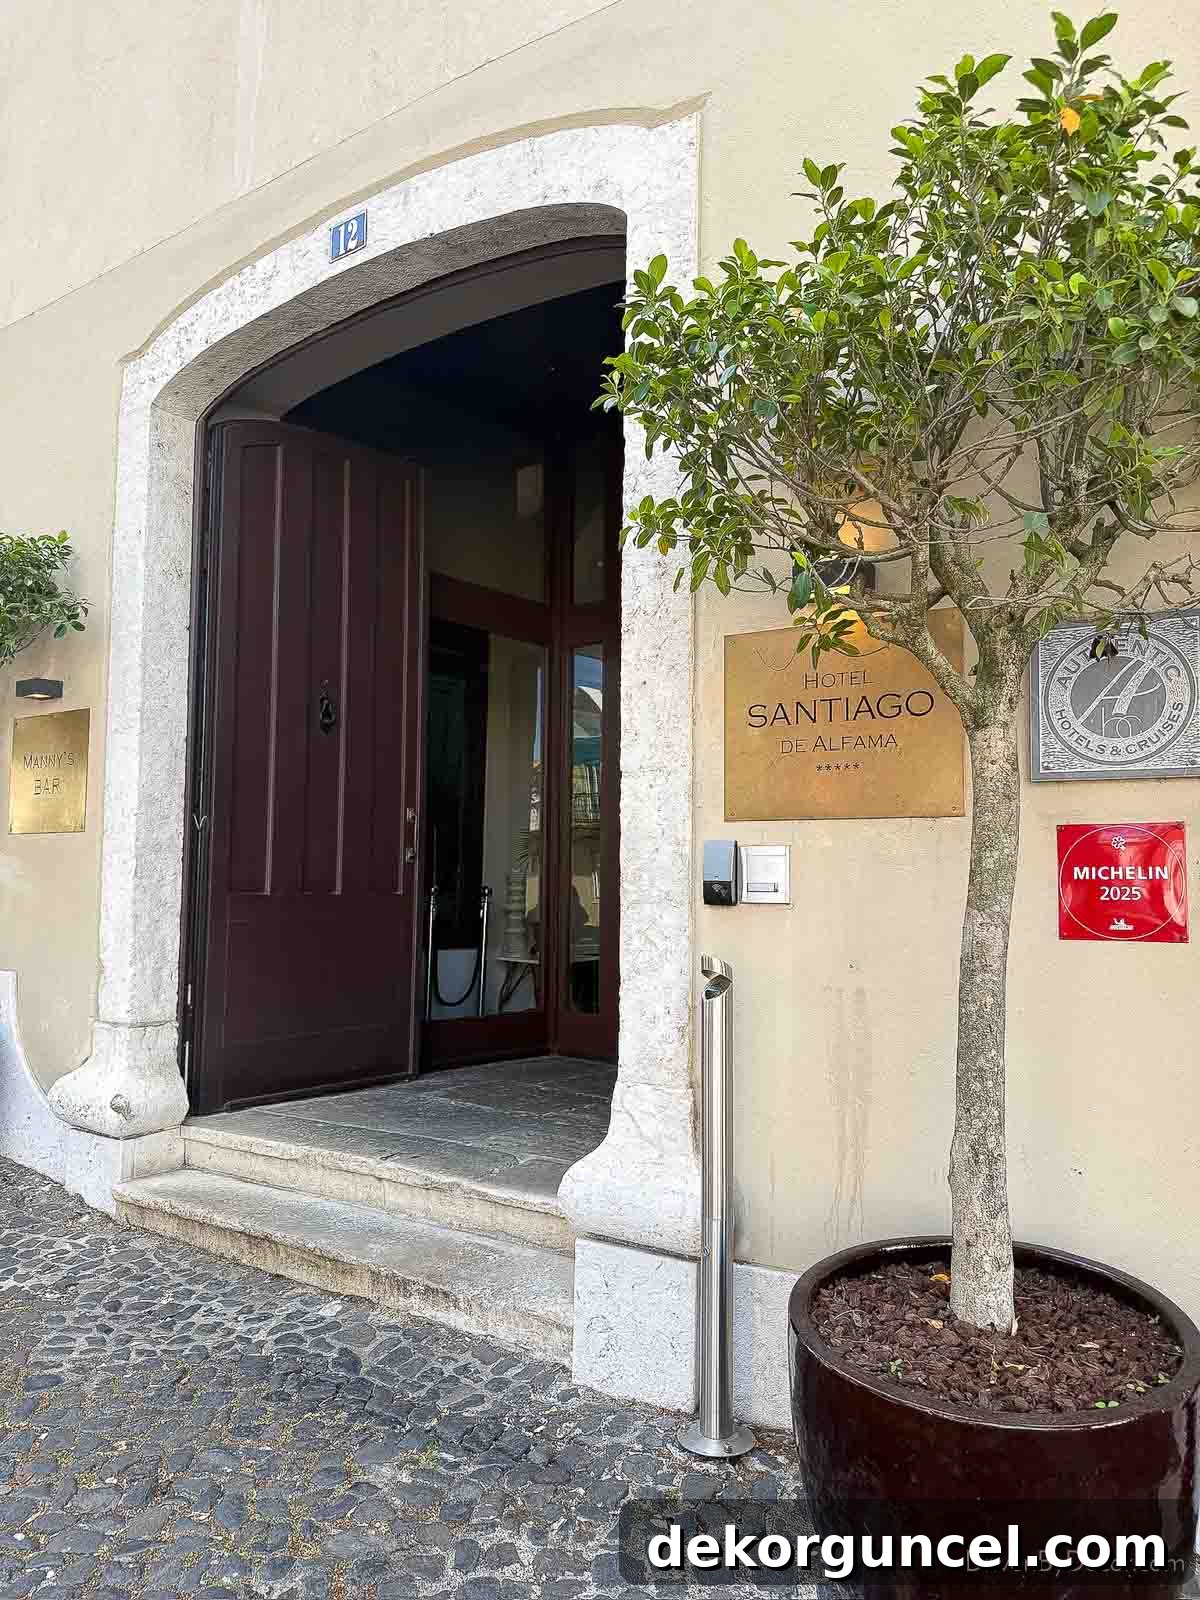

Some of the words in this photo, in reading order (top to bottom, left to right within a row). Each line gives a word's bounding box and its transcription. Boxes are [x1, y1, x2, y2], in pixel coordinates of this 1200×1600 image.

[338, 218, 359, 256] 12
[1055, 637, 1182, 690] AUTENTIC
[803, 669, 873, 689] HOTEL
[747, 690, 935, 728] SANTIAGO
[780, 738, 807, 754] DE
[812, 733, 898, 752] ALFAMA
[23, 751, 75, 769] MANNY'S
[33, 777, 61, 796] BAR
[1073, 866, 1169, 880] MICHELIN
[1099, 886, 1142, 901] 2025
